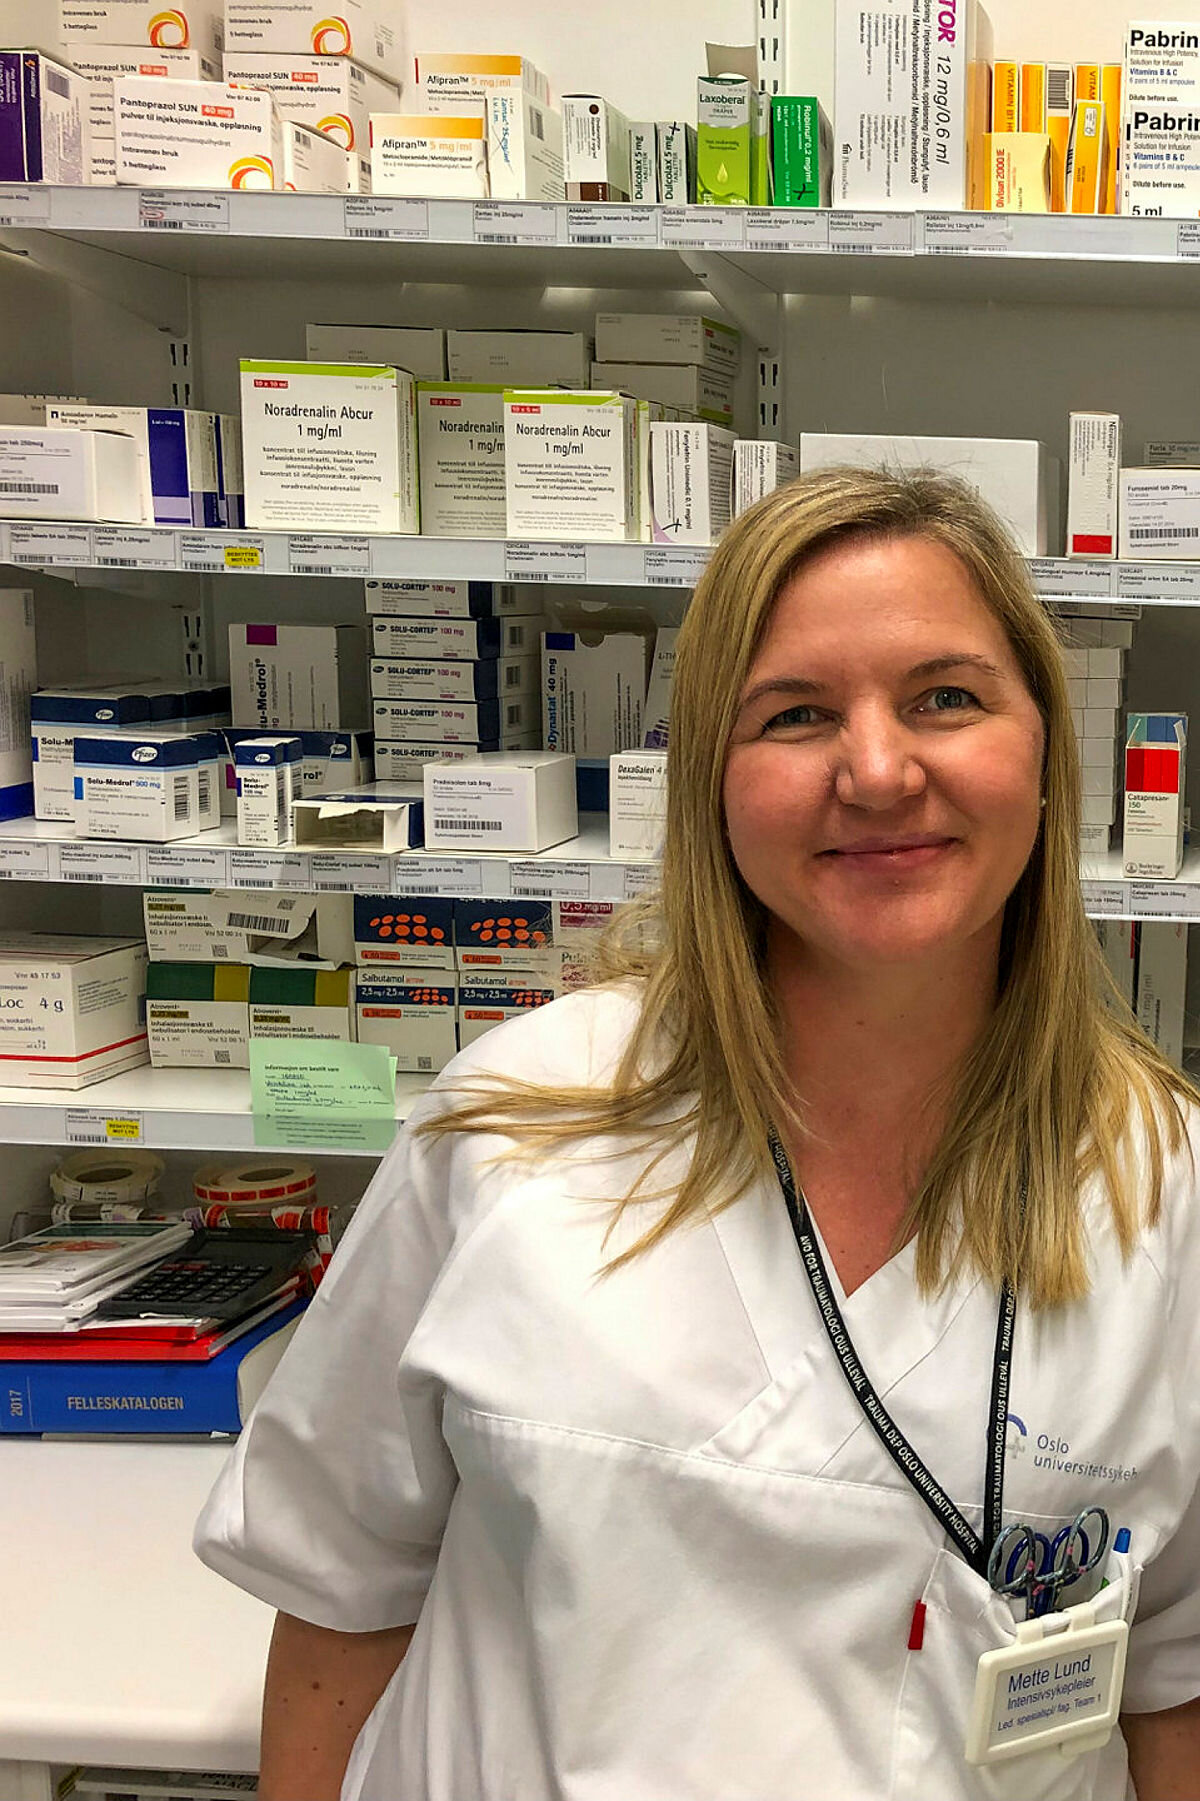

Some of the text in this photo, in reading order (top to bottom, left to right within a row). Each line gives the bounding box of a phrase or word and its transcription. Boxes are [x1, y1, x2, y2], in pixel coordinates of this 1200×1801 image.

[1162, 59, 1183, 67] Infusion
[228, 71, 271, 82] Pantoprazol
[1130, 68, 1158, 76] Vitamins
[480, 78, 511, 87] mg/ml
[1007, 68, 1015, 113] VITAMIN
[120, 97, 198, 112] Pantoprazol SUN
[700, 94, 745, 105] Laxoberal
[933, 55, 950, 165] 12 mg/0,6 ml
[121, 112, 262, 132] pulver injeksjonsvæske, oppløsning
[1134, 132, 1167, 140] Intravenous
[439, 142, 472, 152] mg/ml
[1134, 153, 1164, 161] Vitamins
[996, 157, 1005, 178] 2000
[635, 159, 643, 200] Dulcolax
[665, 159, 674, 200] Dulcolax
[1144, 206, 1162, 215] ml
[264, 403, 373, 420] Noradrenalin Abcur
[307, 424, 342, 440] mg/ml
[440, 420, 504, 433] Noradrenalin
[517, 423, 611, 438] Noradrenalin Abcur
[554, 442, 584, 456] mg/ml
[684, 509, 692, 529] mg/ml
[41, 738, 73, 746] Solu-M
[133, 749, 157, 761] Pfizer
[87, 777, 135, 787] Solu-Medrol®
[362, 974, 404, 984] Salbutamol
[464, 976, 507, 986] Salbutamol
[39, 997, 49, 1010] 4
[151, 1020, 205, 1028] Inhalasjonsvæske
[9, 1389, 23, 1417] 2017
[68, 1396, 184, 1410] FELLESKATALOGEN
[992, 1315, 1013, 1498] TRAUMATOLOGI ULLEVÅL TRAUMA
[810, 1269, 979, 1556] TRAUMATOLOGI ULLEVÅL TRAUMA DEP OSLO UNIVERSITY HOSPITAL
[1037, 1434, 1069, 1454] Oslo
[1008, 1654, 1091, 1693] Mette Lund
[1008, 1677, 1096, 1710] Intensivsykepleier
[1074, 1696, 1095, 1707] Team
